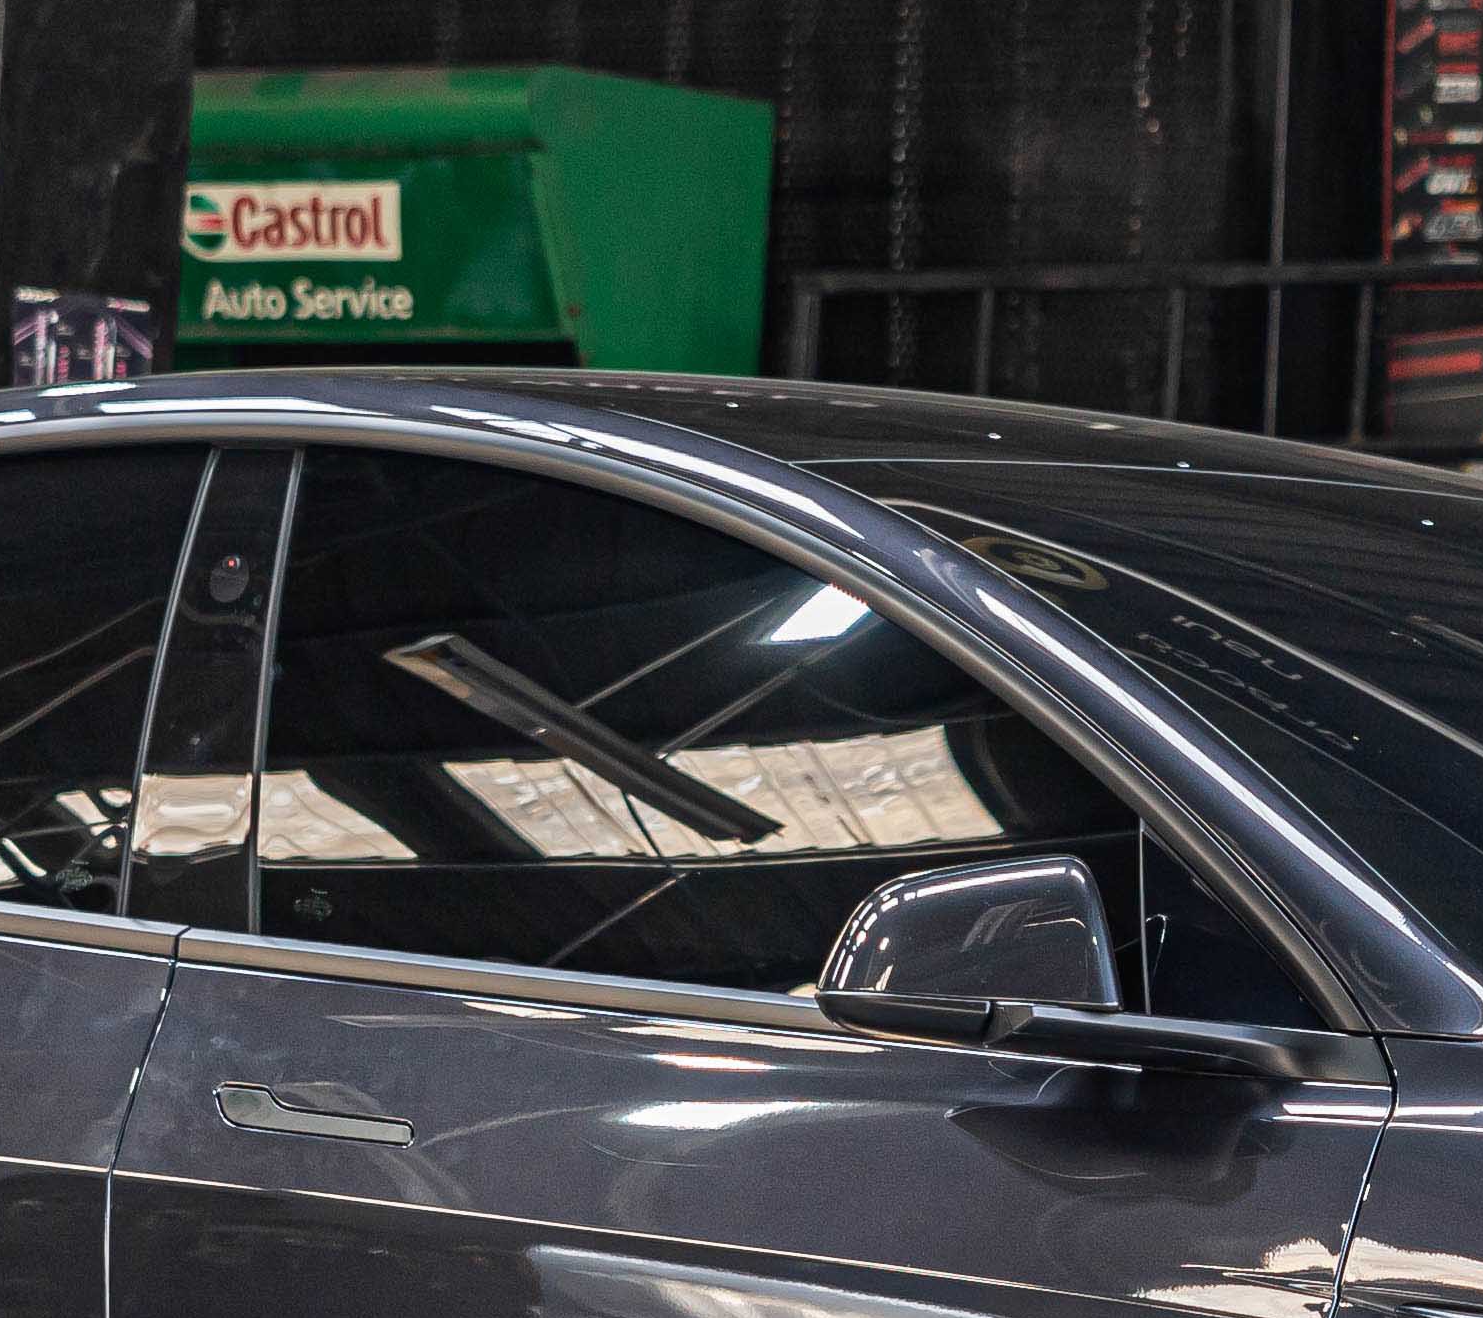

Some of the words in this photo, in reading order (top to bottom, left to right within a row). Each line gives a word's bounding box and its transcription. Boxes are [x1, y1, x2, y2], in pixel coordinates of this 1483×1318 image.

[230, 195, 383, 253] Castrol
[203, 280, 285, 321] Auto
[291, 278, 413, 321] Service
